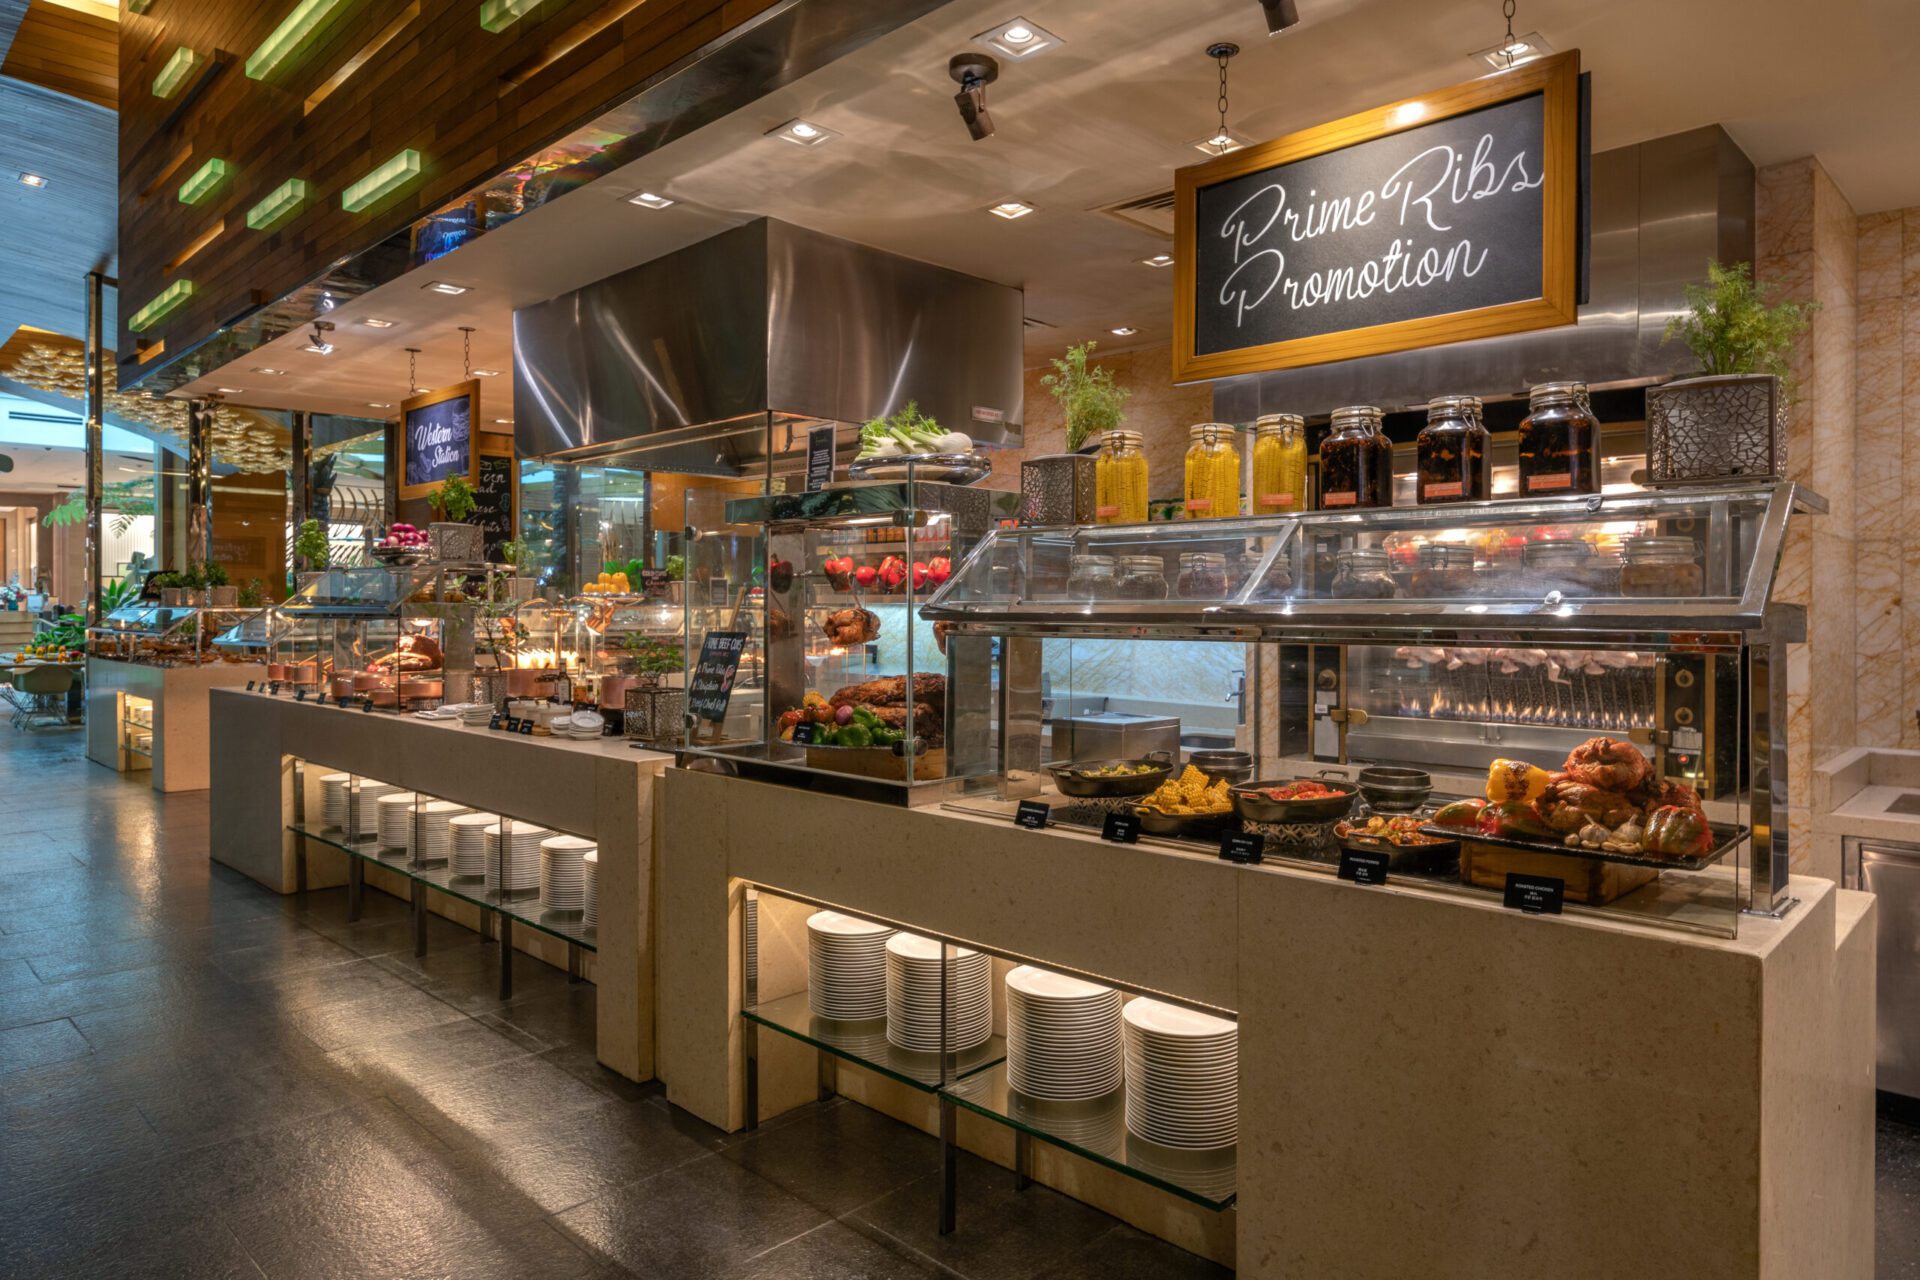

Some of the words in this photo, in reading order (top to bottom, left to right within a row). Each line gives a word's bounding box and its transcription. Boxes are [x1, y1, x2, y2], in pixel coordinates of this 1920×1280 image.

[1220, 183, 1377, 264] Prime
[1380, 133, 1544, 232] Ribs
[1218, 239, 1488, 328] Promotion
[414, 422, 452, 451] Western
[432, 444, 459, 468] Station
